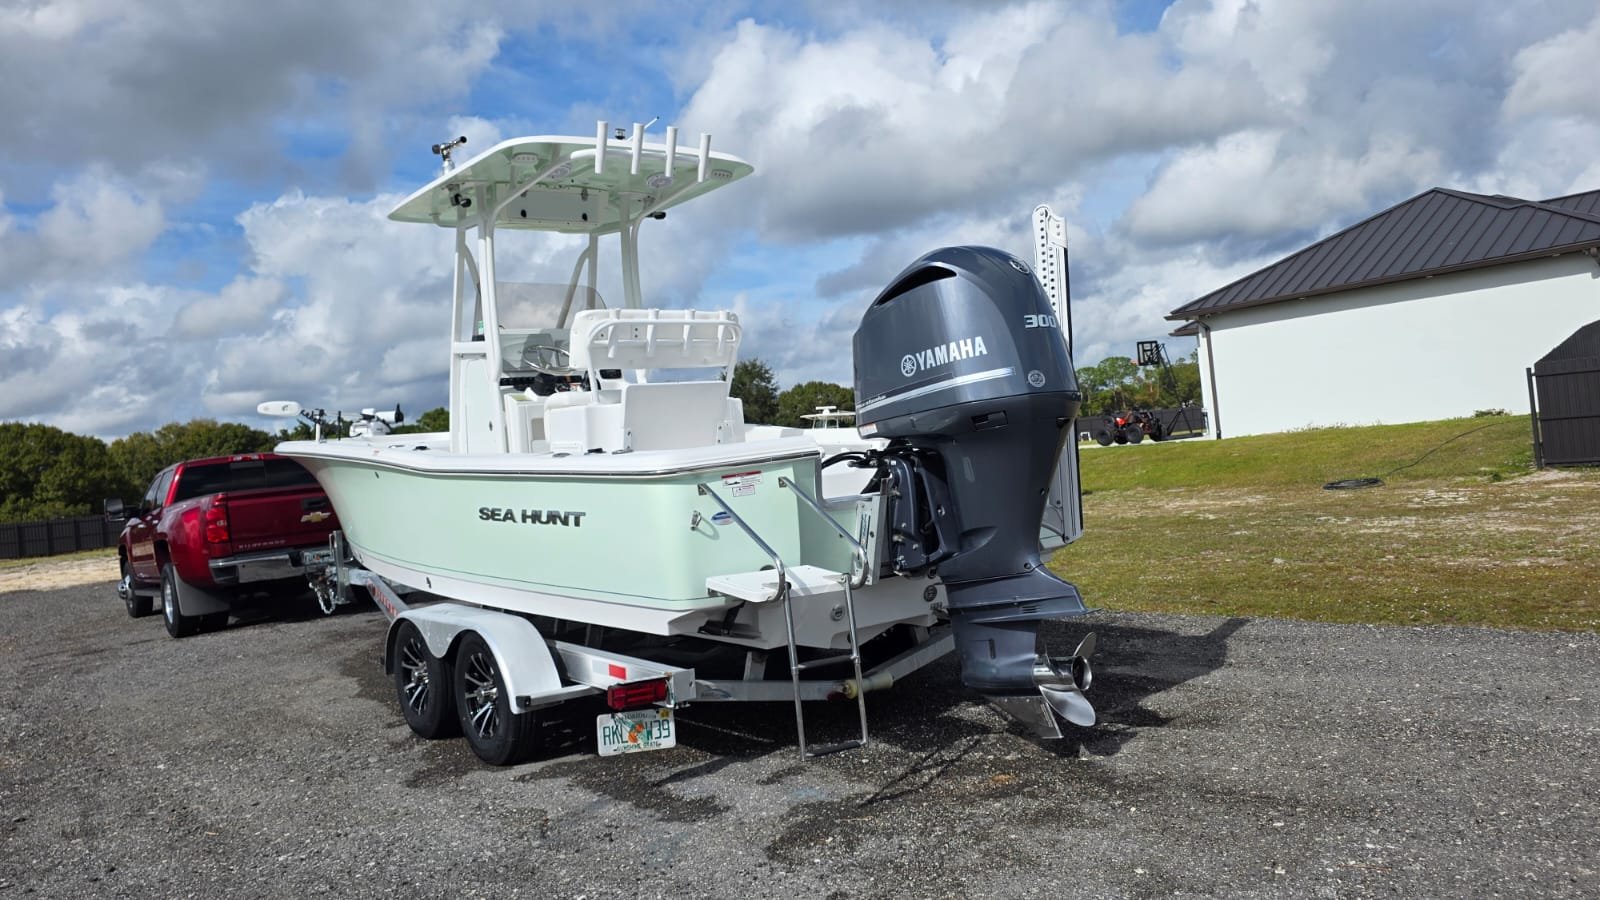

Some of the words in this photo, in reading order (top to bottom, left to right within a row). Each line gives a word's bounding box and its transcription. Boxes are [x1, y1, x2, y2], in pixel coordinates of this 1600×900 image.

[1023, 314, 1057, 329] 300
[915, 335, 988, 371] YAMAHA
[478, 506, 518, 523] SEA
[521, 508, 587, 528] HUNT
